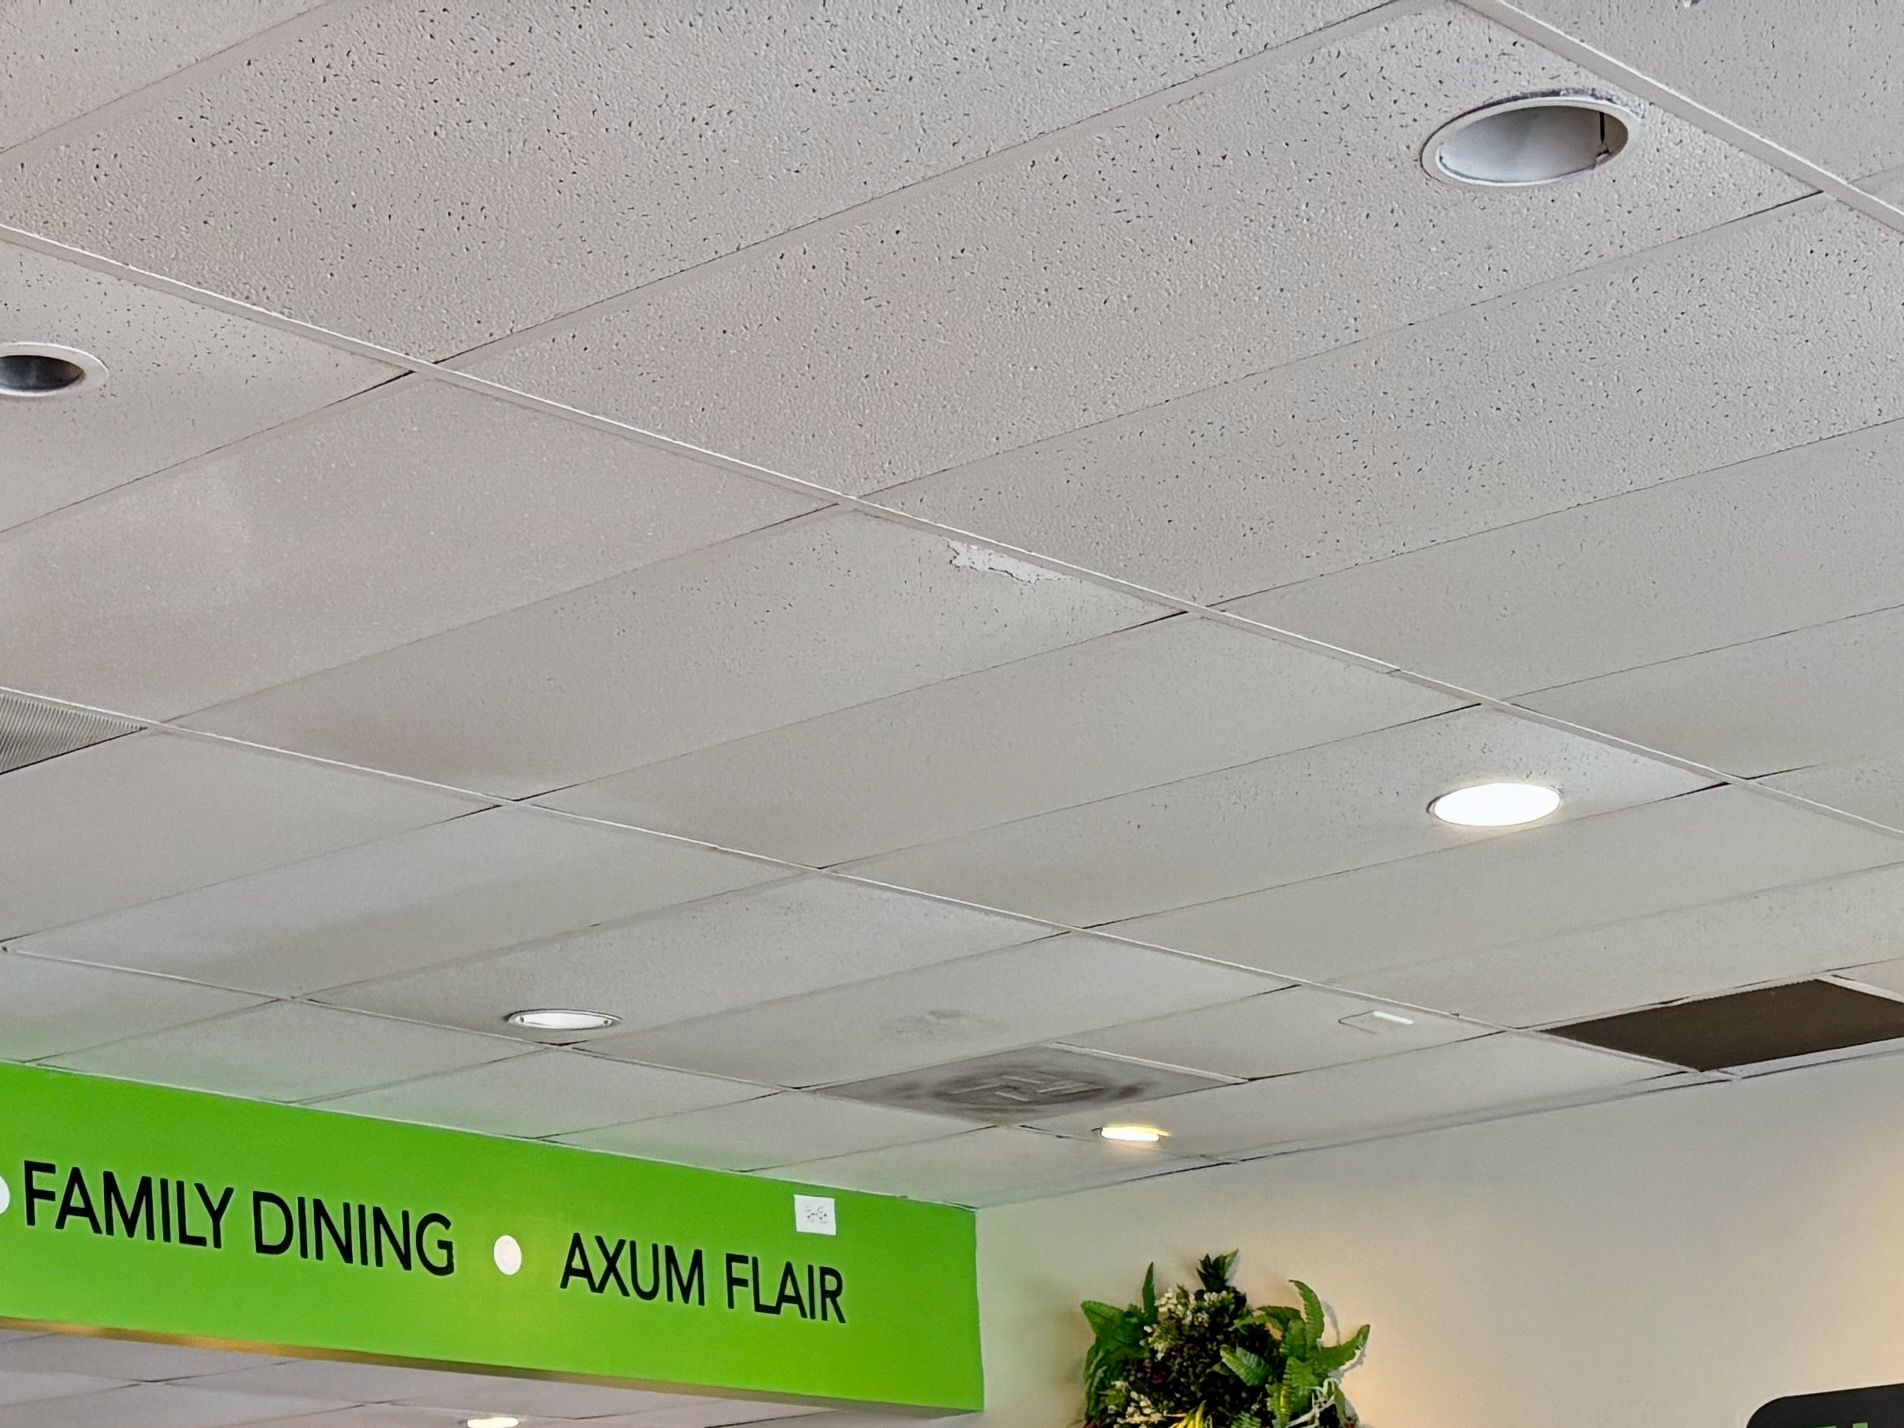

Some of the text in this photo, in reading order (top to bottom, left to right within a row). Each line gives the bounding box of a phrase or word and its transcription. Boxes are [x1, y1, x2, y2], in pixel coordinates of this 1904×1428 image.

[23, 1160, 455, 1276] FAMILY DINING
[560, 1232, 847, 1324] AXUM FLAIR
